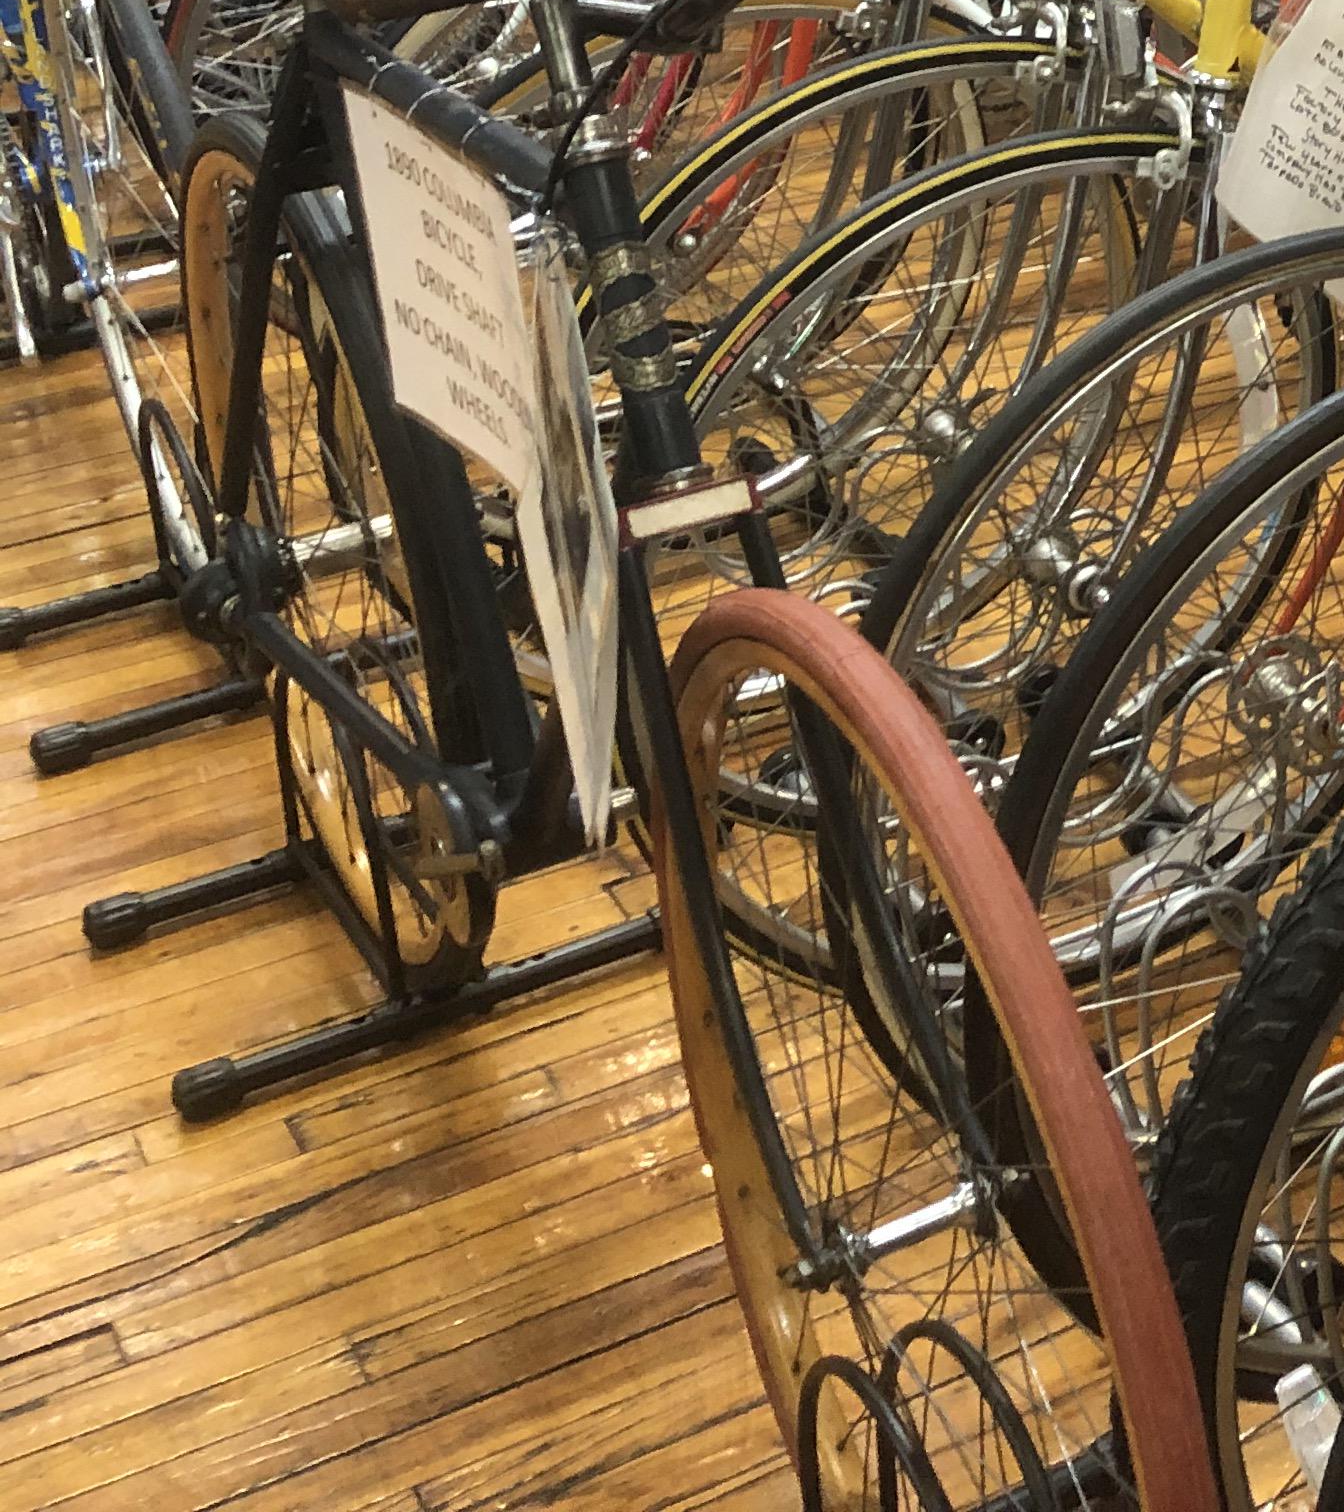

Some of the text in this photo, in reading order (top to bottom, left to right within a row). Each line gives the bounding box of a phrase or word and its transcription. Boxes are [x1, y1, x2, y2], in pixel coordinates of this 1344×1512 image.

[385, 140, 496, 240] 1890 COLUMBIA
[420, 209, 484, 281] BICYCLE,
[394, 298, 421, 335] NO
[415, 257, 505, 348] DRIVE SHAFT
[446, 375, 510, 449] WHEELS
